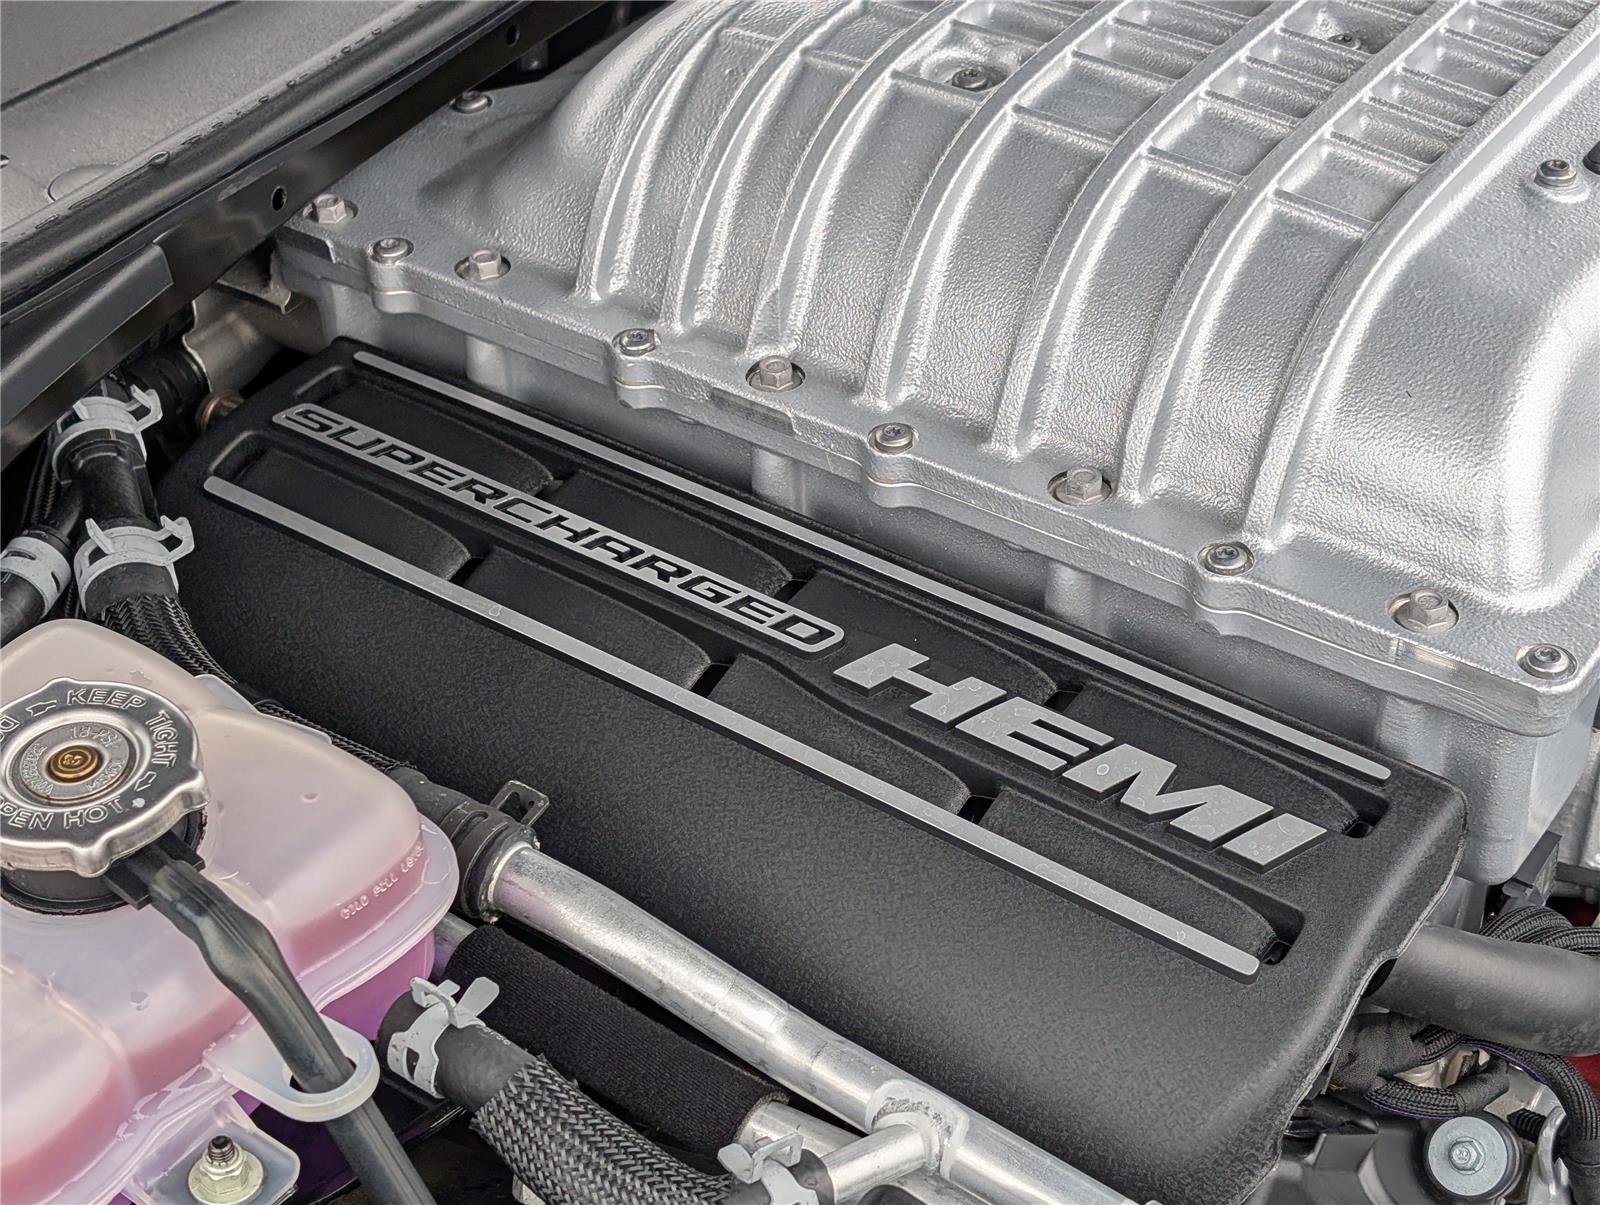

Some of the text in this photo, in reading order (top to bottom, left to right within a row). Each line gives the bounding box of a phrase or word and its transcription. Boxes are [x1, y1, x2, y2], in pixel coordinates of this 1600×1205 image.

[287, 406, 838, 647] SUPERCHARGED
[66, 688, 180, 768] KEEP TIGHT
[833, 643, 1327, 868] HEMI
[0, 796, 55, 830] PEN
[63, 795, 126, 830] HOT
